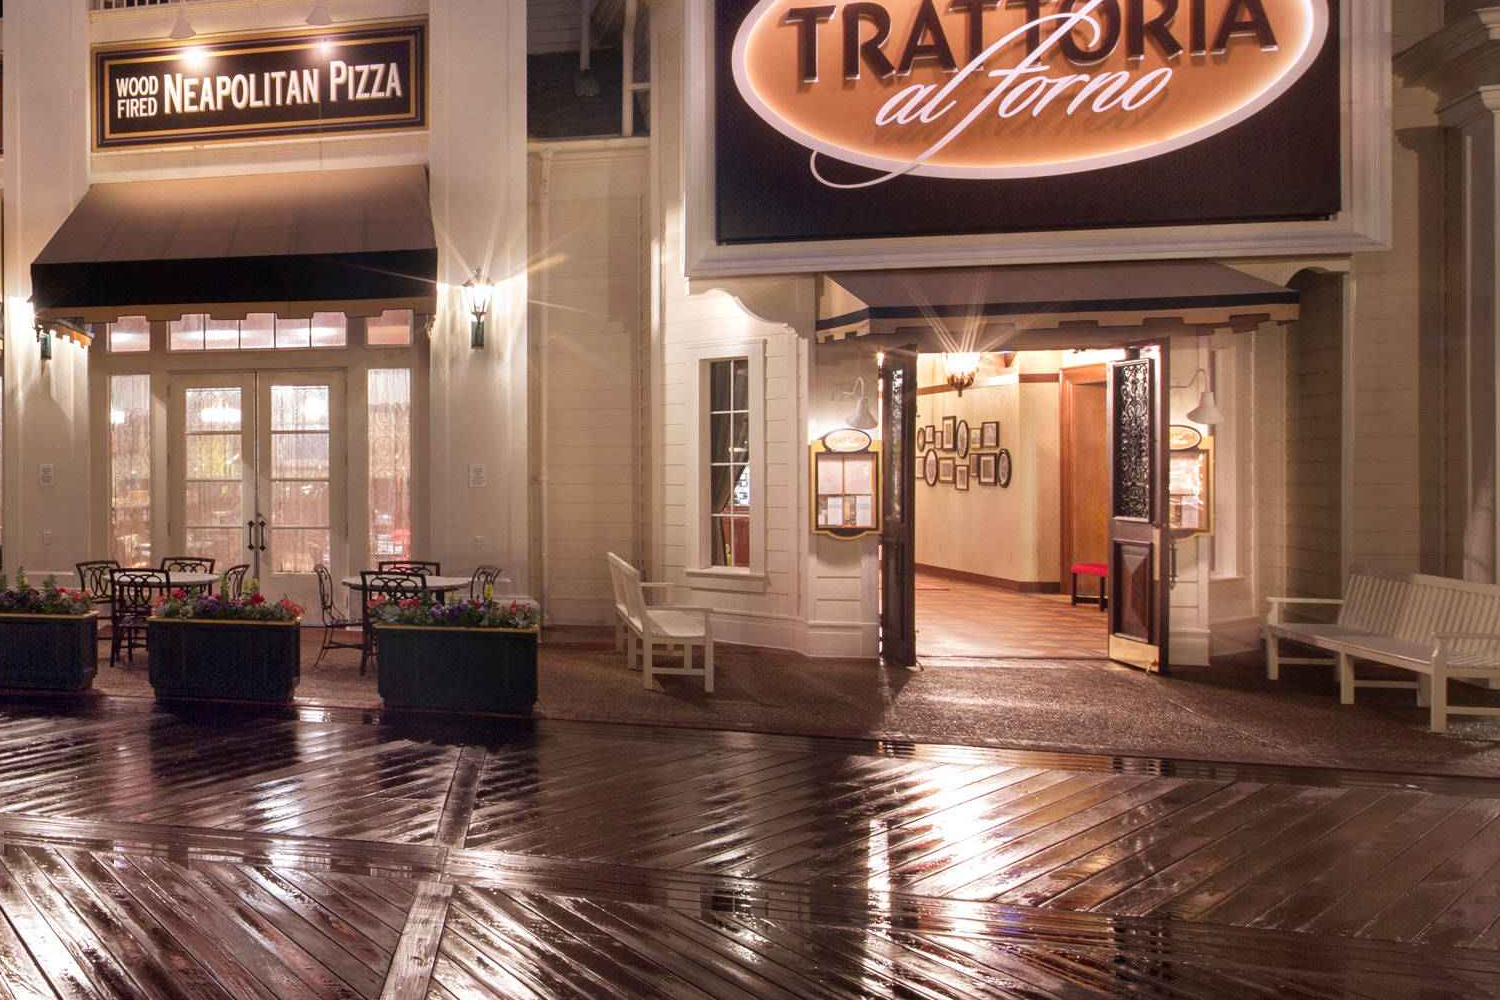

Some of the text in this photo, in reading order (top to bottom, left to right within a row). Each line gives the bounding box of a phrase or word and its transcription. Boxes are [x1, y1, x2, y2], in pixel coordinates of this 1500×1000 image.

[115, 75, 159, 98] WOOD
[163, 60, 402, 115] NEAPOLITAN PIZZA
[116, 98, 158, 119] FIRED
